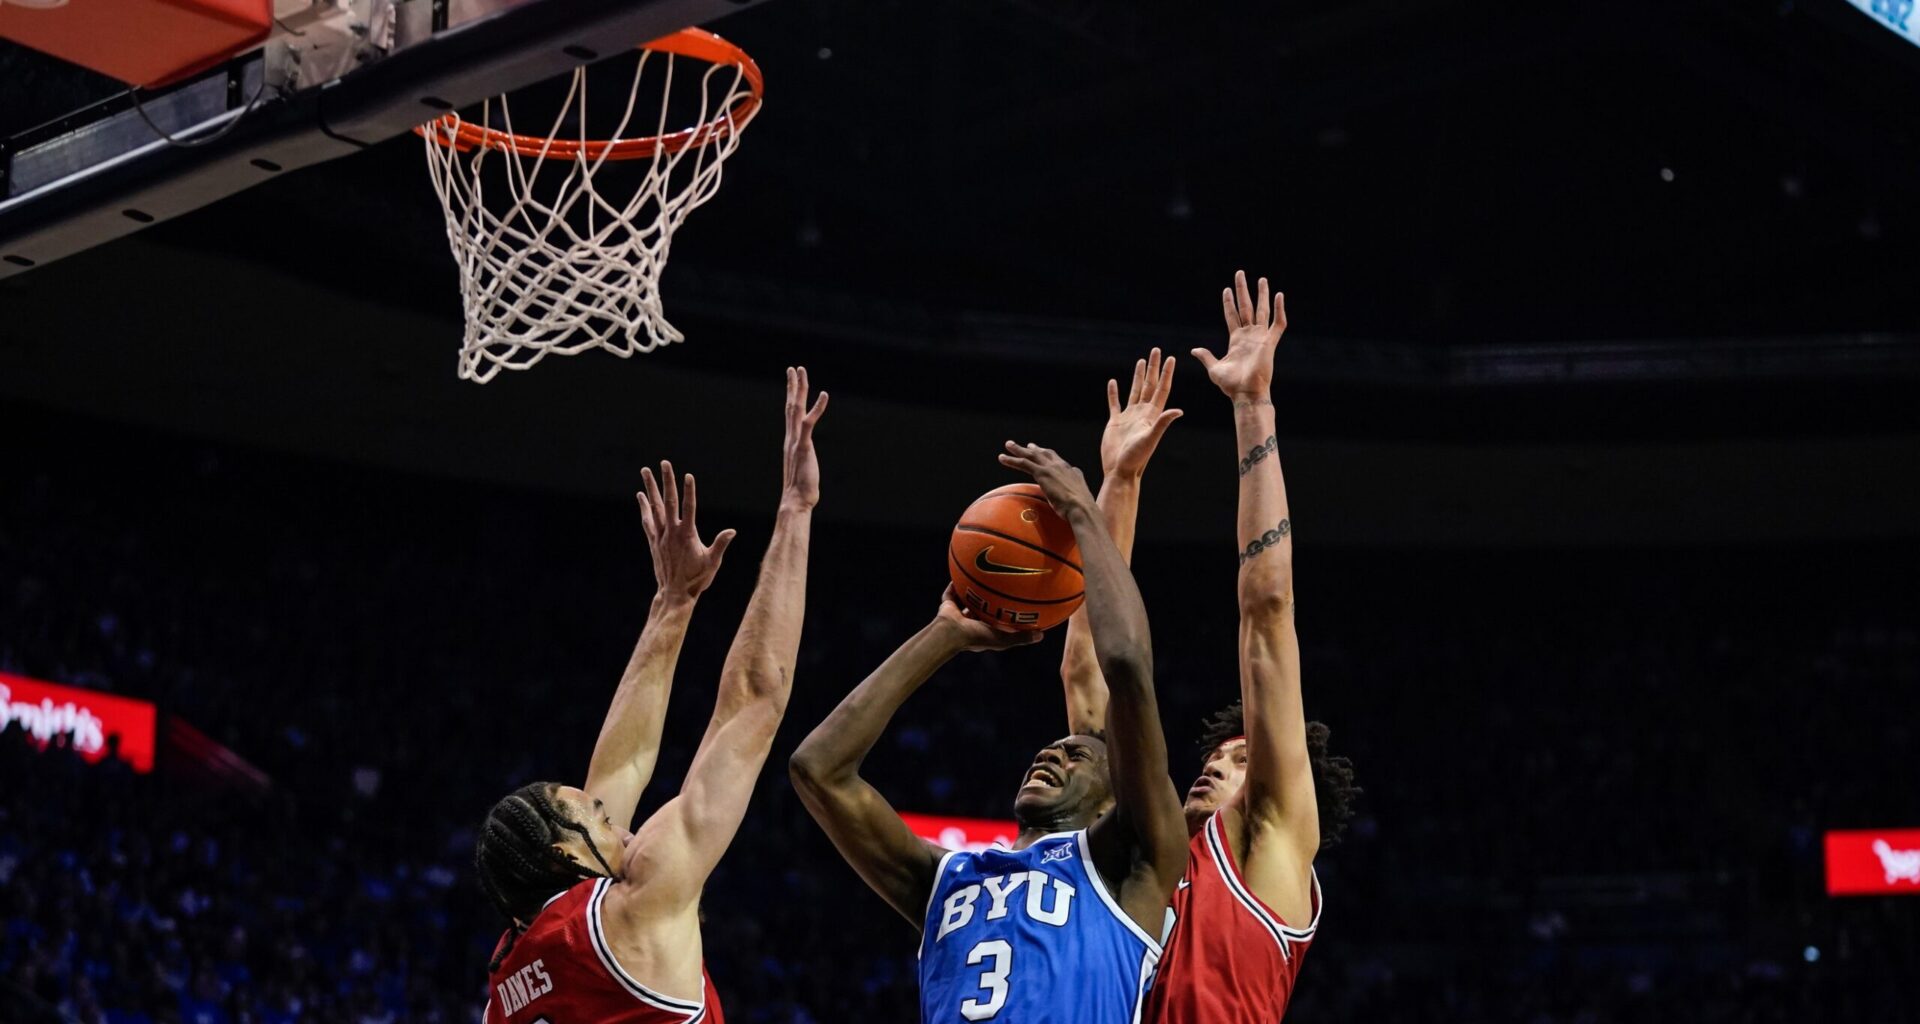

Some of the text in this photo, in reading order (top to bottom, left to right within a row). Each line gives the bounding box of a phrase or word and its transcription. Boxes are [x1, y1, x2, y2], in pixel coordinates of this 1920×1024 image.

[965, 586, 1040, 625] ELITE
[936, 870, 1076, 943] BYU
[496, 959, 553, 1018] DAWES
[960, 939, 1013, 1022] 3
